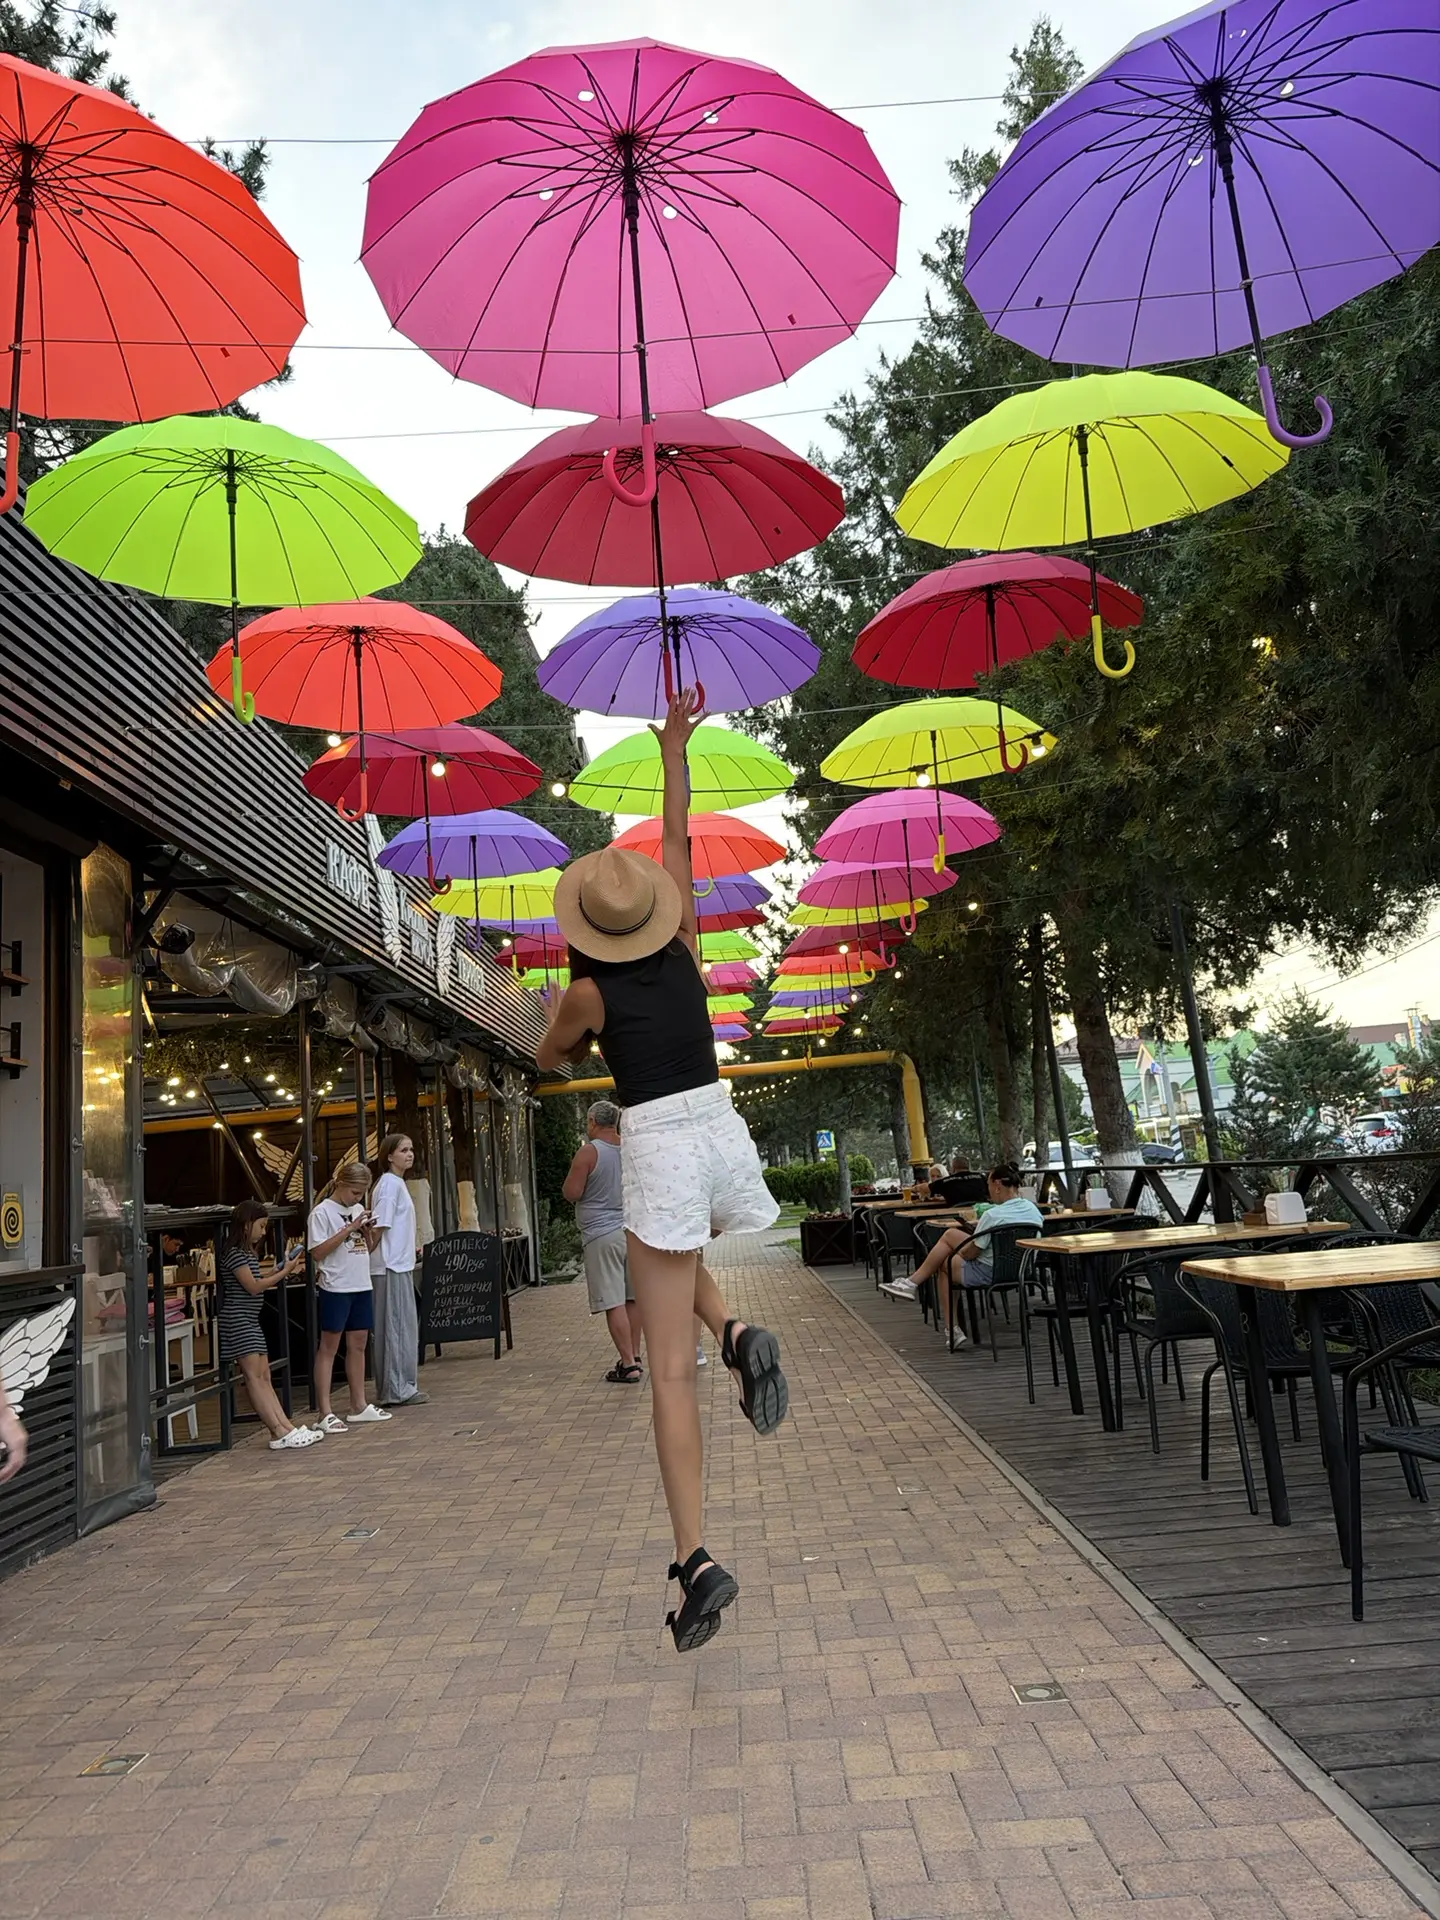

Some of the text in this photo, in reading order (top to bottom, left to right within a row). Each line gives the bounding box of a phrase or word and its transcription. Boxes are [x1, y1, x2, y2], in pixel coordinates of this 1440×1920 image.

[326, 838, 371, 912] КАФЕ
[431, 1238, 489, 1257] КОМПЛЕКС
[429, 1305, 458, 1318] САЛАТ
